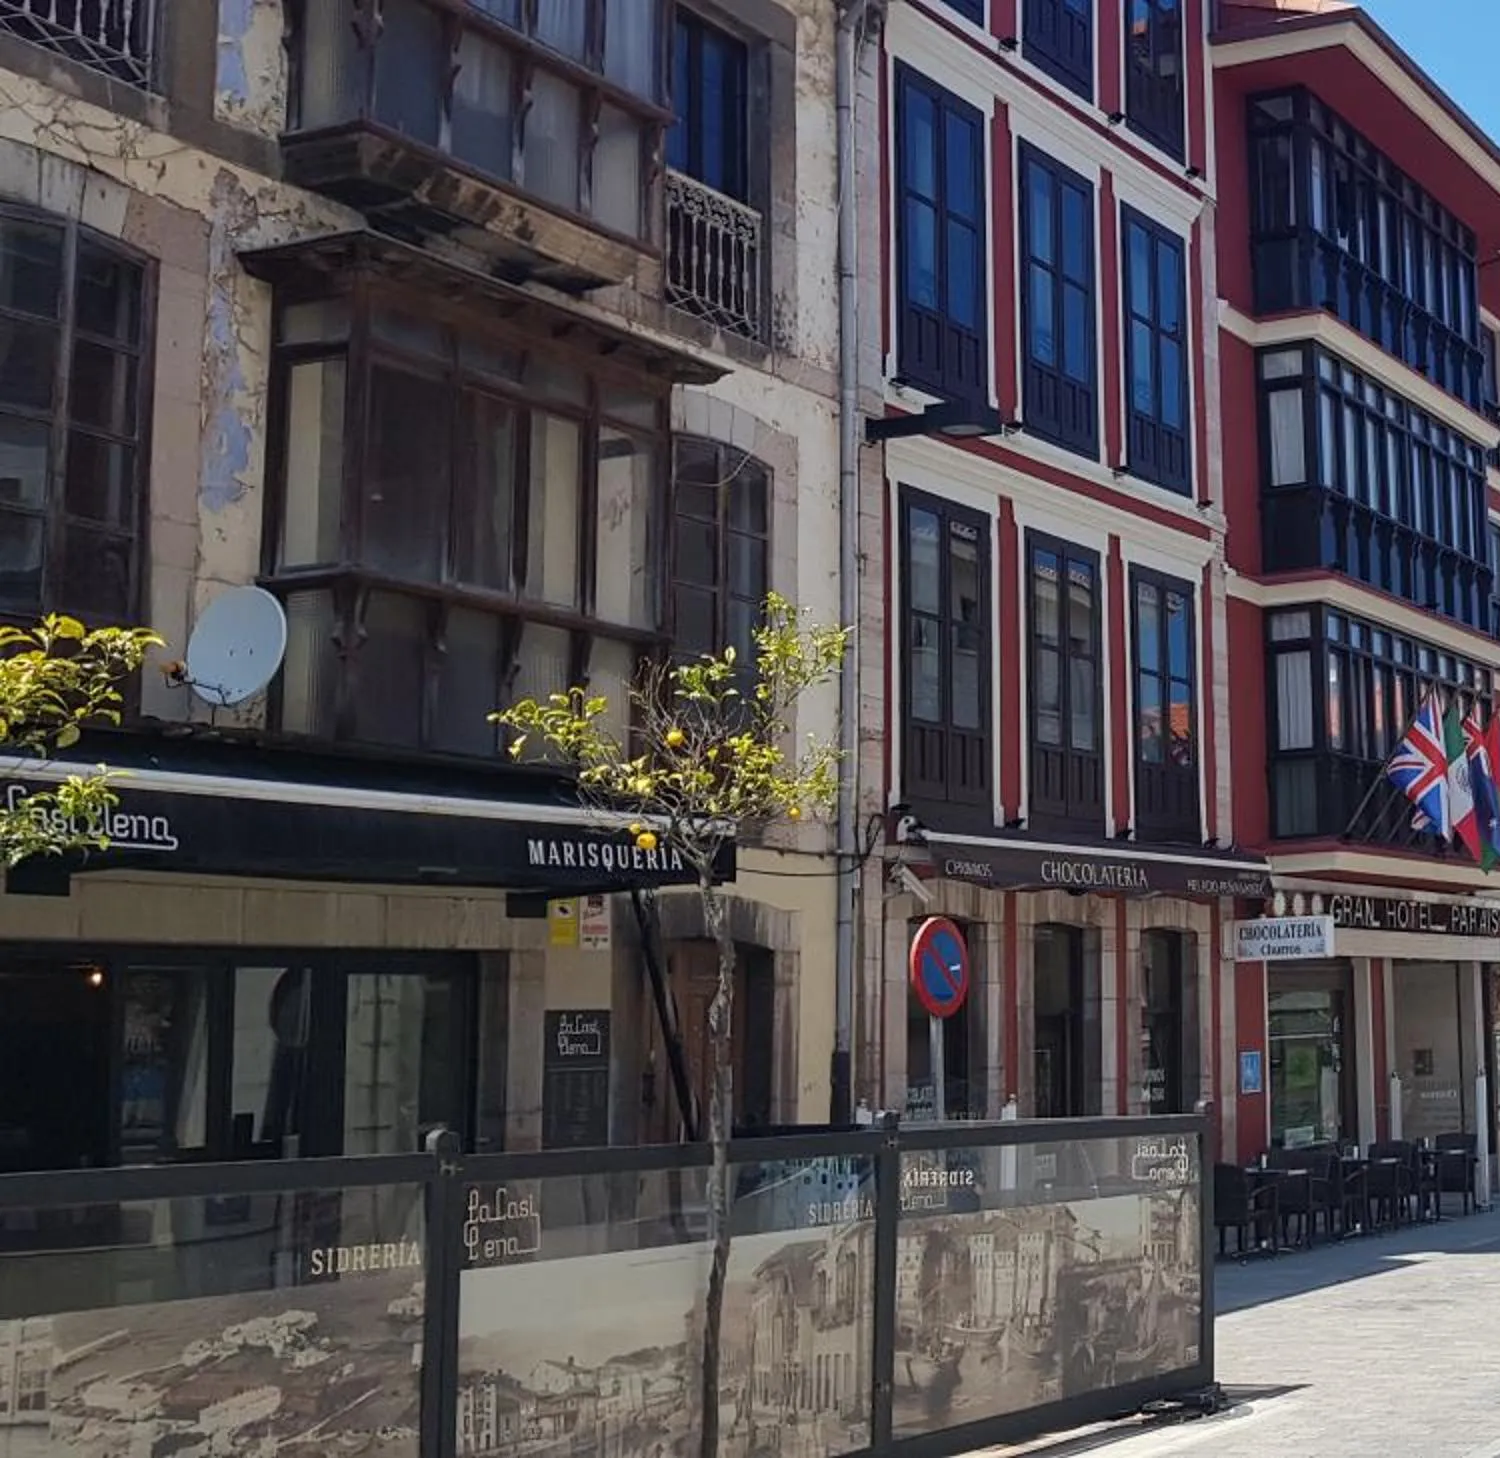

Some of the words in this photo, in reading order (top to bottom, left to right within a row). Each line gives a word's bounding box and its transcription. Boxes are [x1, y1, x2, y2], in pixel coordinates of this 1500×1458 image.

[527, 836, 683, 872] MARISQUERÍA
[1329, 895, 1376, 927] GRAN
[1385, 897, 1447, 930] HOTEL
[1240, 922, 1322, 940] CHOCOLATERÍA
[809, 1193, 873, 1224] SIDRERÍA
[311, 1234, 421, 1275] SIDRERÍA
